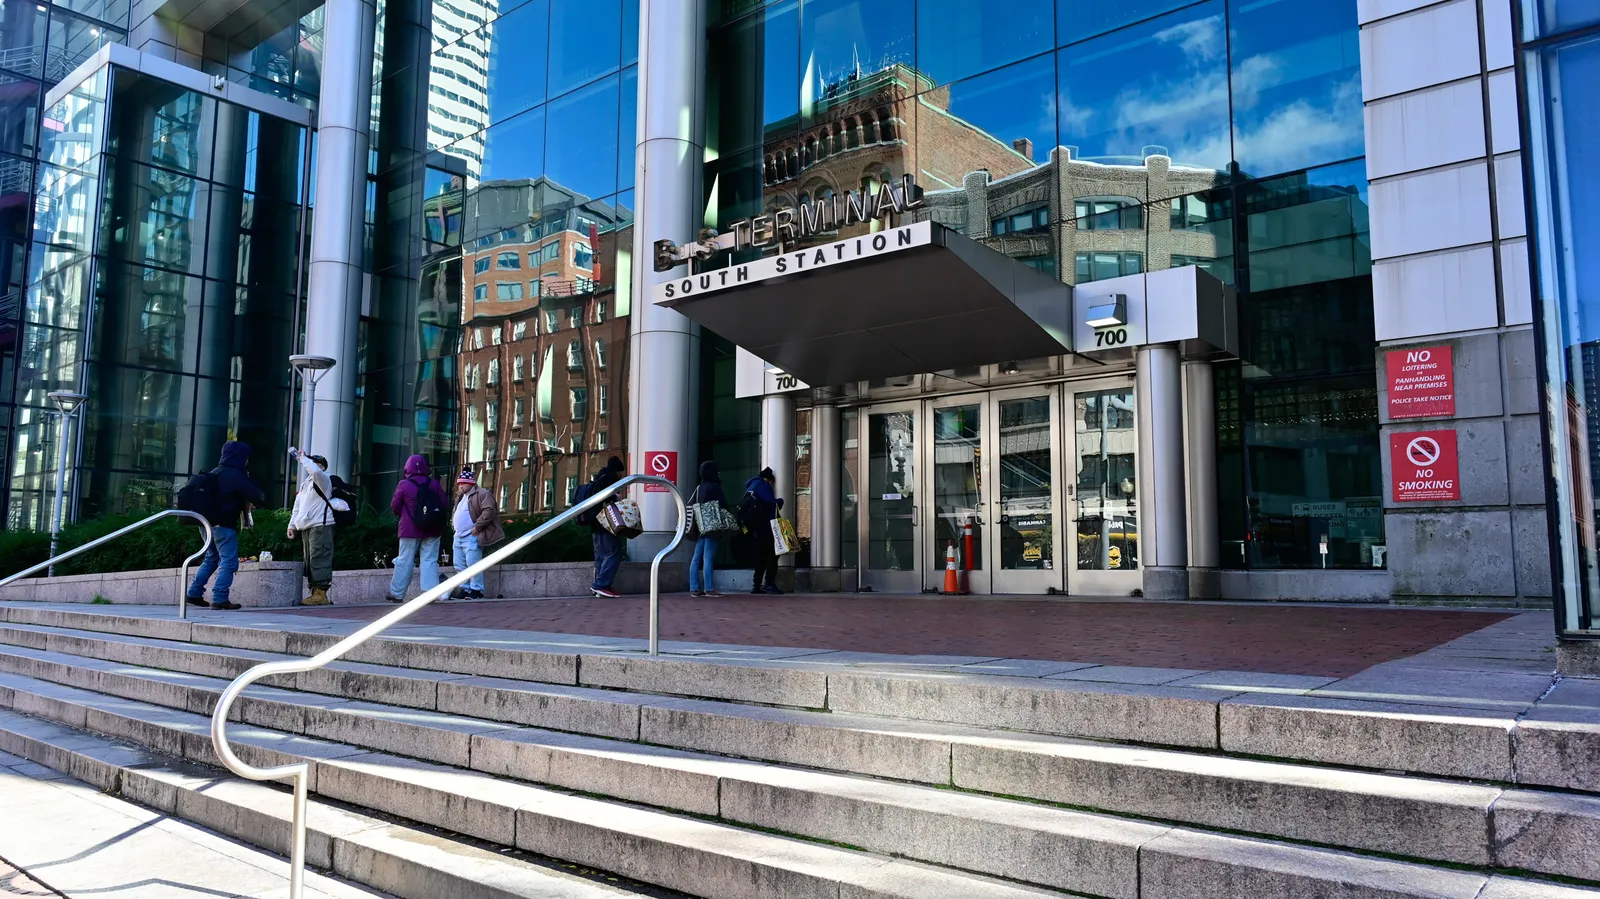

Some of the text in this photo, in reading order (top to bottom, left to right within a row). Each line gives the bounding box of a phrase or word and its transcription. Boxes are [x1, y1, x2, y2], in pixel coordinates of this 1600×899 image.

[728, 173, 925, 251] TERMINAL
[665, 228, 911, 298] SOUTH STATION
[1094, 328, 1127, 347] 700
[1406, 350, 1431, 364] NO
[1402, 363, 1437, 371] LOITERING
[776, 376, 797, 390] 700
[1395, 374, 1446, 384] PANHANDLING
[1414, 381, 1448, 390] PREMISES
[1415, 469, 1434, 478] NO
[1398, 479, 1453, 490] SMOKING
